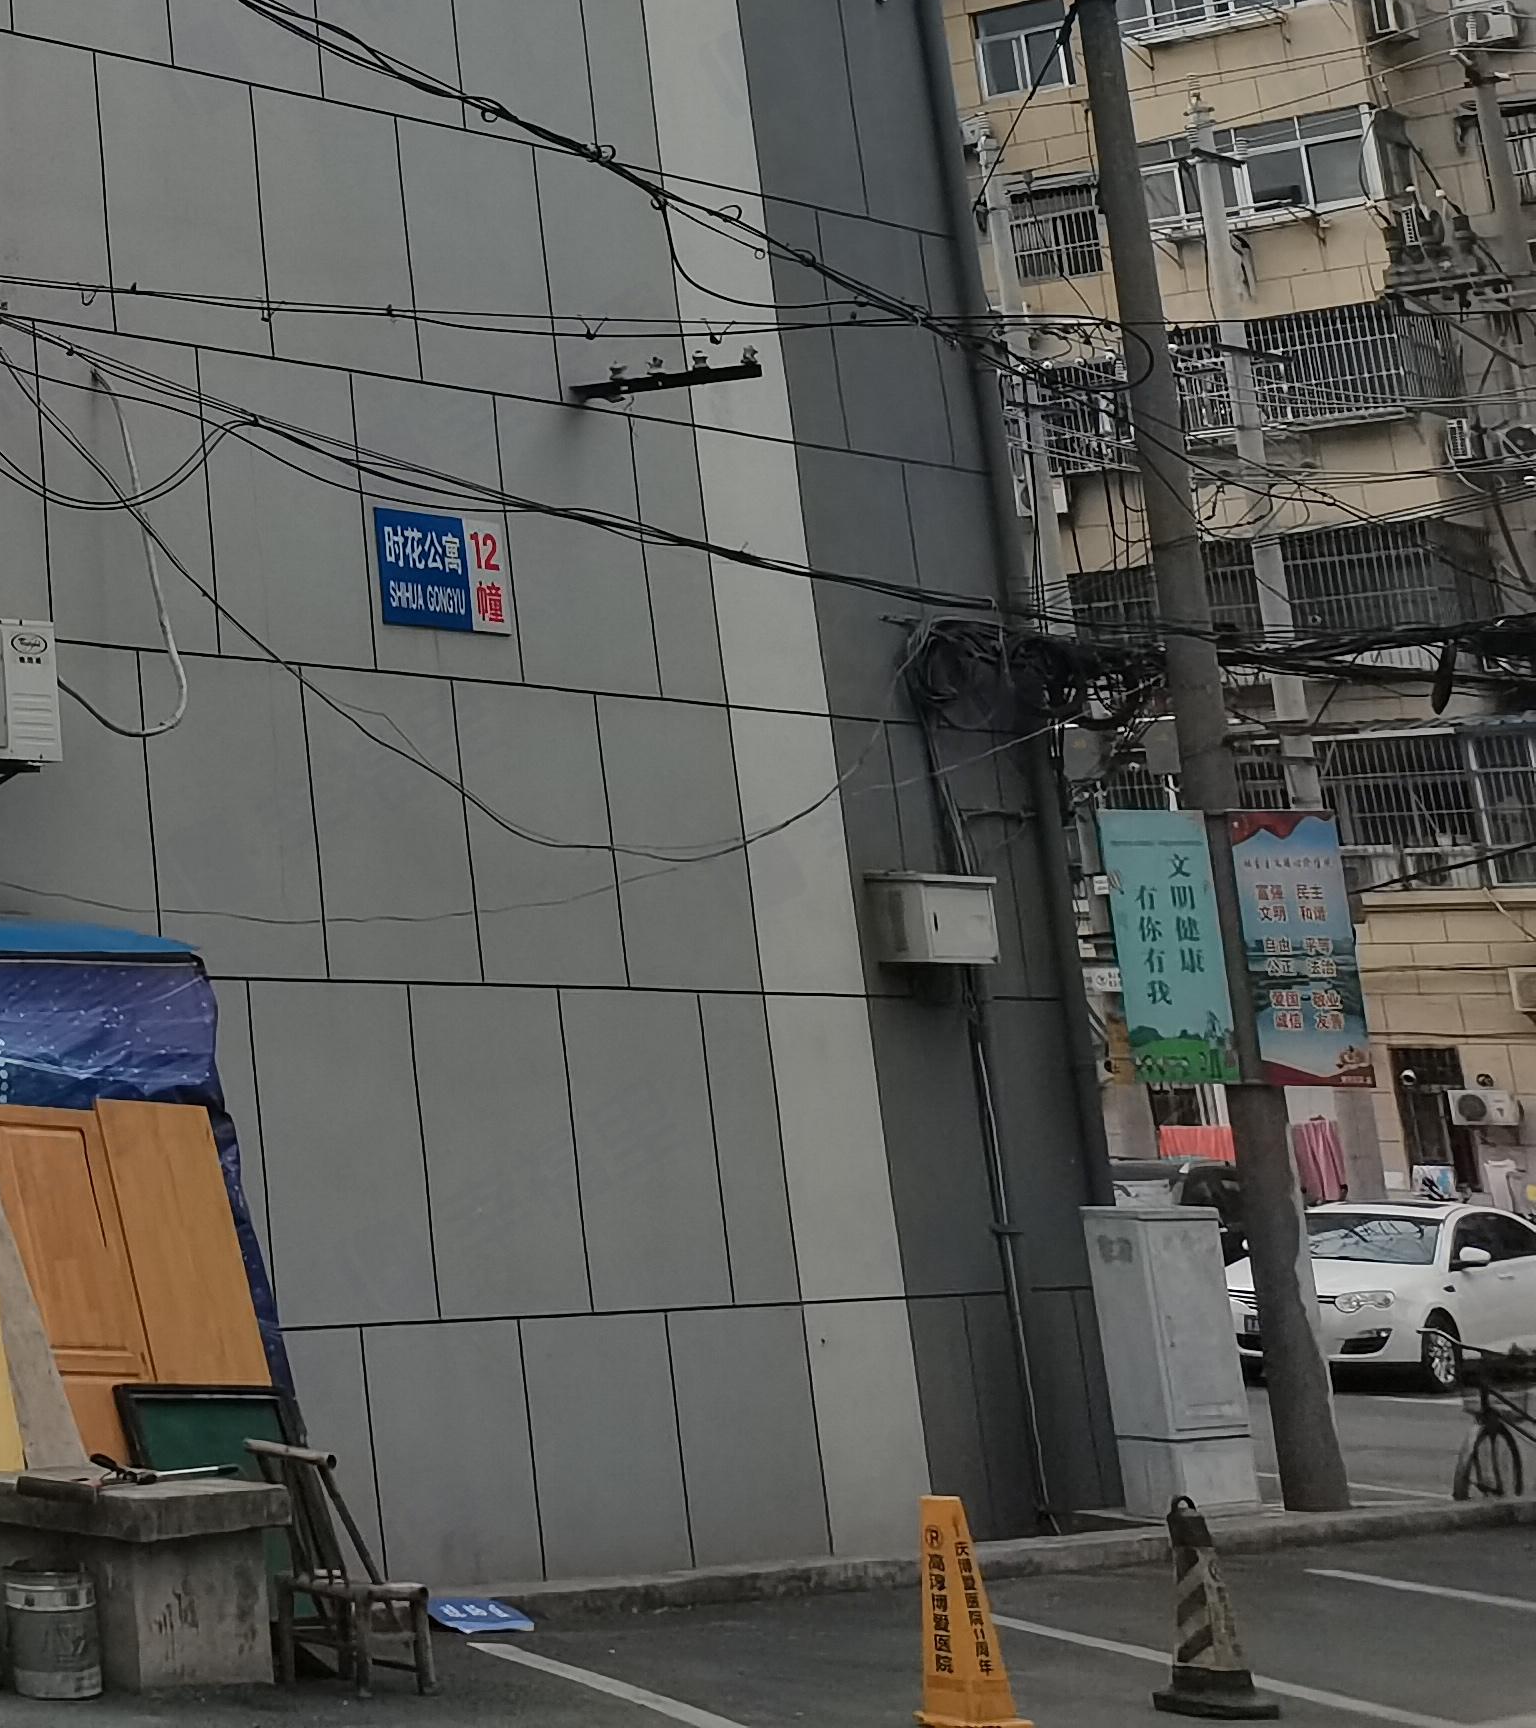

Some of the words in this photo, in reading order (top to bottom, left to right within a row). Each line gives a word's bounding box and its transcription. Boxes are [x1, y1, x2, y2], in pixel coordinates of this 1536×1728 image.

[383, 525, 463, 575] 时花公寓
[470, 531, 500, 572] 12
[389, 579, 424, 610] SHIHUA
[426, 584, 466, 615] GONGYU
[476, 581, 505, 623] 幢
[1168, 852, 1206, 975] 文明健康
[1259, 906, 1286, 921] 文明
[1135, 884, 1173, 1006] 有你有我
[1267, 958, 1294, 974] 公正
